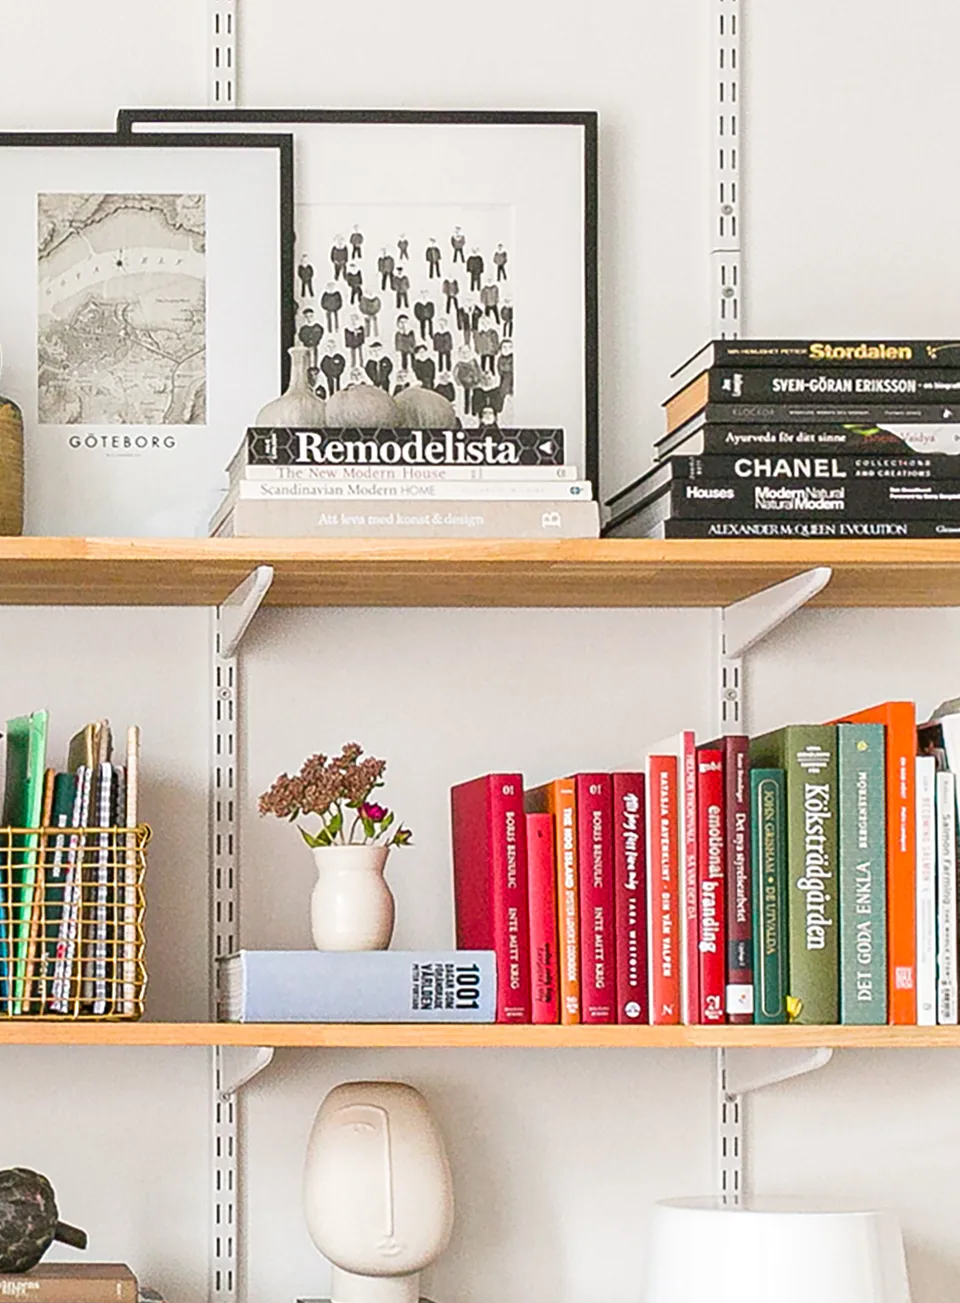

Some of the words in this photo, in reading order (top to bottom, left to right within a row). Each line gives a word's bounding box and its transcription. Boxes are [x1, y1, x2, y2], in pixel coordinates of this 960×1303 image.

[809, 343, 913, 360] Stordalen
[772, 375, 853, 393] SVEN-GÖRAN
[855, 378, 916, 393] ERIKSSON
[69, 432, 176, 449] GÖTEBORG
[295, 430, 521, 465] Remodelista
[725, 431, 776, 445] Ayurveda
[778, 431, 793, 443] för
[796, 431, 814, 443] ditt
[817, 432, 846, 443] sinne
[276, 466, 305, 479] The
[308, 466, 338, 479] New
[342, 466, 396, 479] Modern
[402, 466, 446, 479] House
[735, 458, 847, 477] CHANEL
[855, 459, 931, 467] COLLECTIONS
[260, 483, 344, 496] Scandinavian
[346, 483, 398, 496] Modern
[400, 485, 436, 496] HOME
[686, 485, 734, 499] Houses
[317, 512, 339, 526] Att
[341, 512, 366, 526] leva
[367, 512, 394, 526] med
[396, 512, 430, 526] konst
[431, 512, 442, 526] &
[442, 512, 484, 528] design
[708, 523, 779, 535] ALEXANDER
[839, 523, 908, 535] EVOLUTION
[659, 771, 670, 816] NATASJA
[764, 790, 776, 821] JOHN
[505, 811, 517, 843] BORIS
[563, 808, 573, 826] THE
[592, 811, 603, 842] BORIS
[735, 812, 747, 831] Det
[708, 805, 724, 879] emotional
[732, 833, 745, 851] nya
[942, 813, 953, 856] Salmon
[765, 823, 776, 874] GRISHAM
[564, 851, 574, 889] ISLAND
[796, 783, 833, 950] Köksträdgården
[765, 886, 776, 902] DE
[855, 861, 872, 914] ENKLA
[941, 858, 953, 904] Farming
[661, 892, 672, 911] DIN
[508, 907, 518, 933] INTE
[594, 907, 604, 933] INTE
[661, 914, 673, 935] VÄN
[699, 881, 720, 953] branding
[766, 903, 777, 956] UTVALDA
[856, 921, 872, 964] GODA
[662, 937, 672, 977] VALPEN
[420, 964, 434, 1010] VÄRLDEN
[456, 964, 480, 1010] 1001
[509, 963, 520, 990] KRIG
[595, 963, 606, 989] KRIG
[857, 971, 872, 1001] DET
